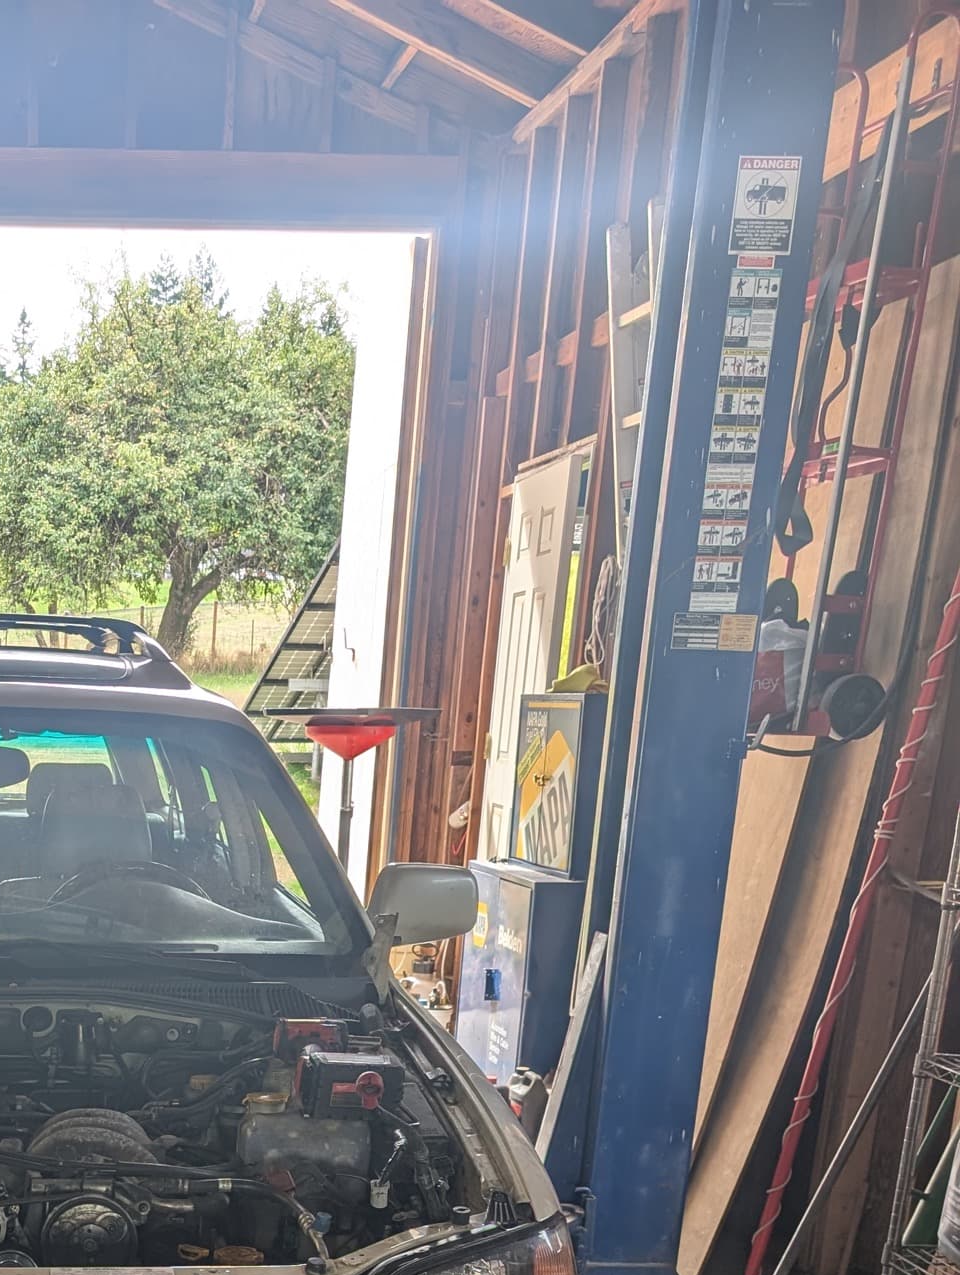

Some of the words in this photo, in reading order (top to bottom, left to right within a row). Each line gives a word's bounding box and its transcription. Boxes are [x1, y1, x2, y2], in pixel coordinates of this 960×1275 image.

[753, 159, 799, 169] DANGER
[524, 770, 570, 865] NAPA
[497, 924, 522, 955] Belden
